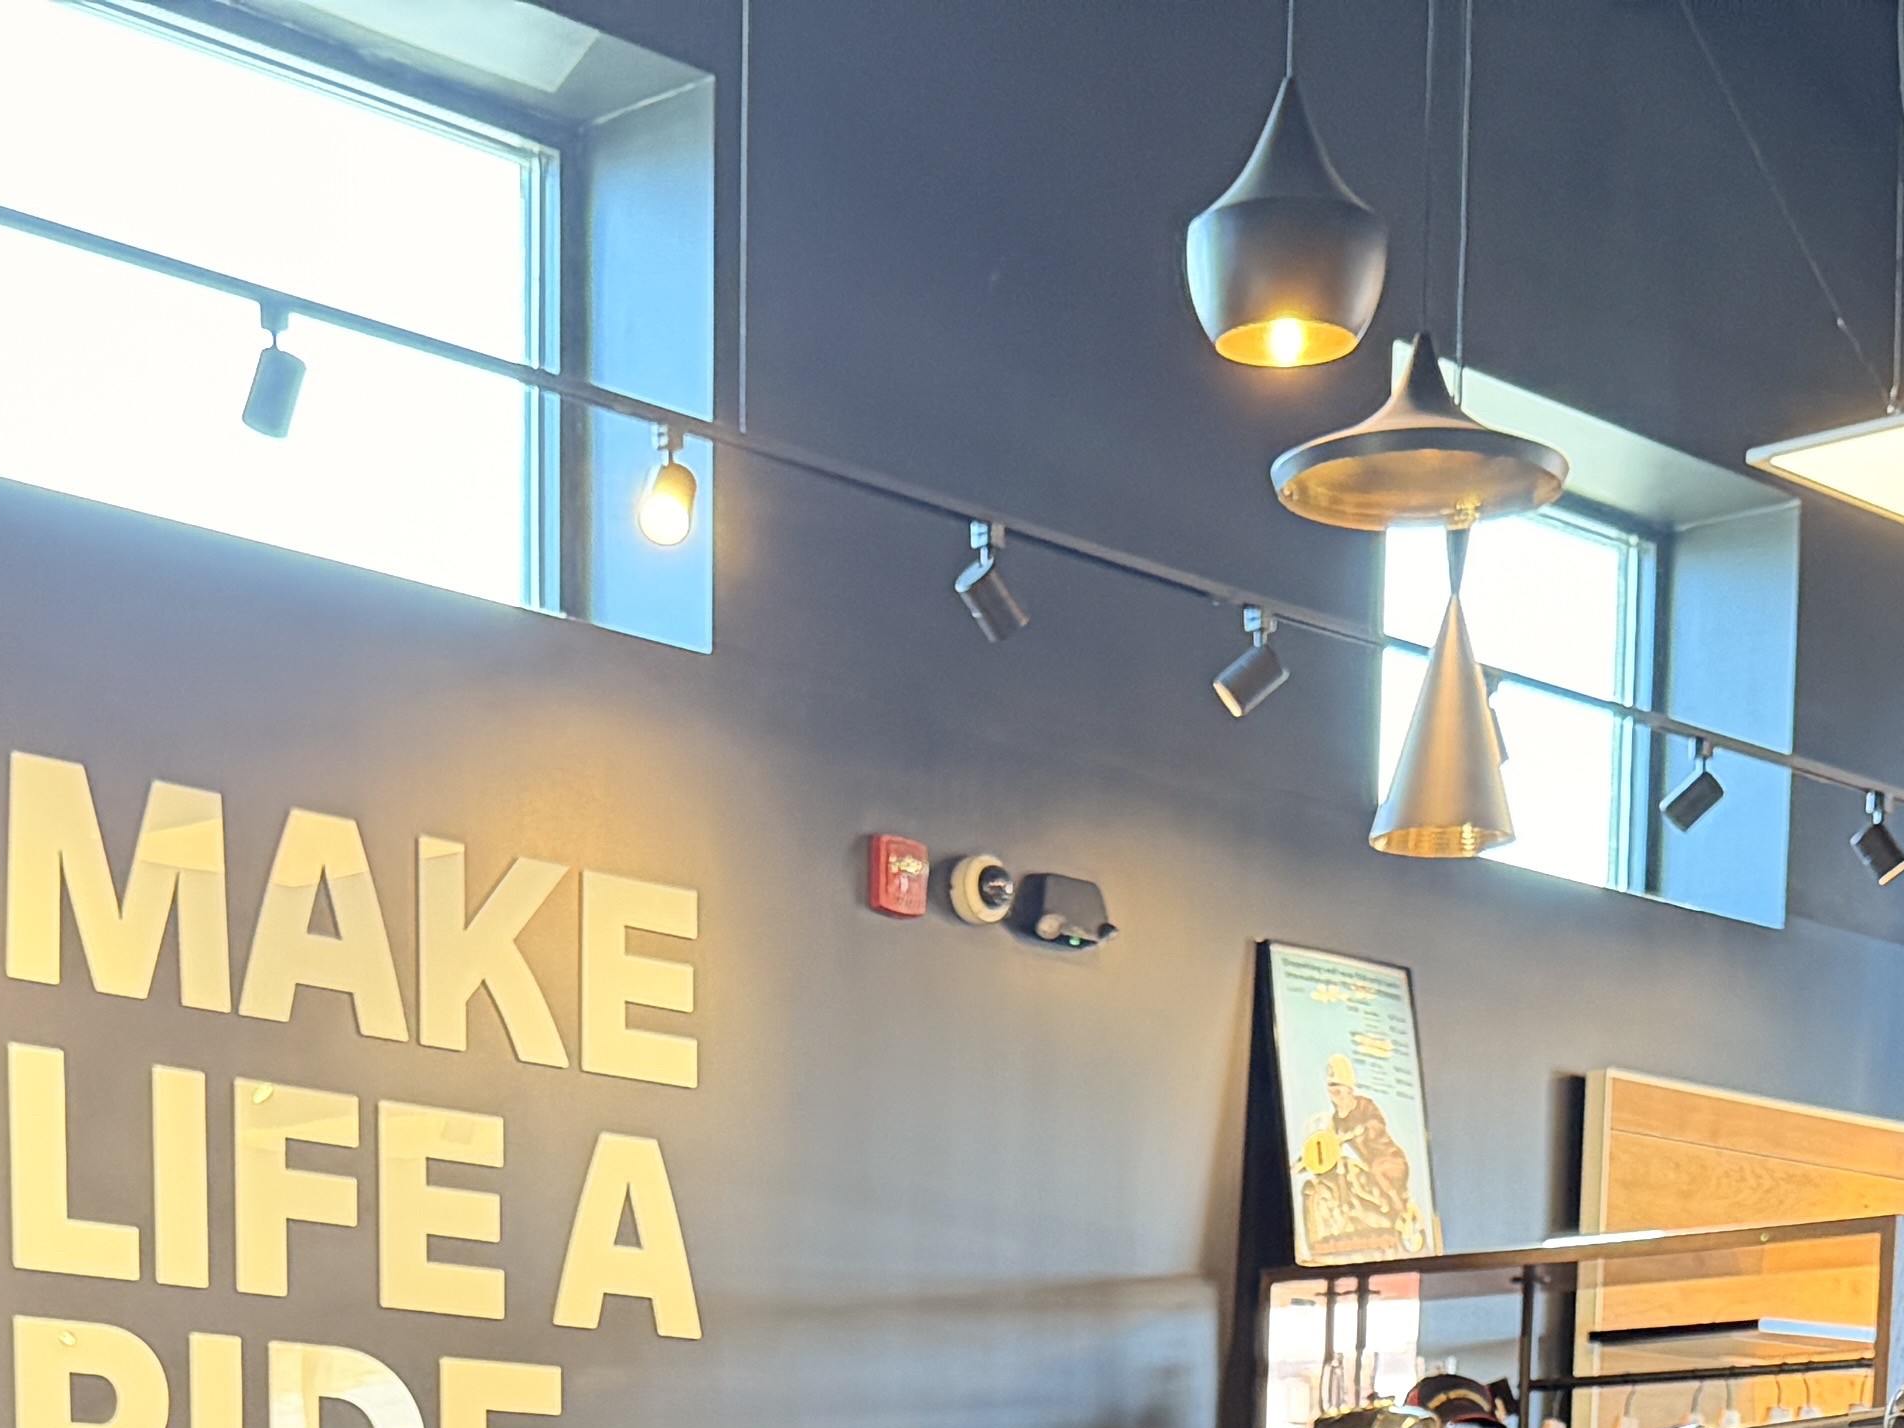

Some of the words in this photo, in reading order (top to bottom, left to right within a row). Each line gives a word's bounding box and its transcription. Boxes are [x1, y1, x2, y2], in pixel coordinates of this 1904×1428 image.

[6, 751, 698, 1088] MAKE
[7, 1041, 505, 1320] LIFE
[552, 1132, 702, 1340] A
